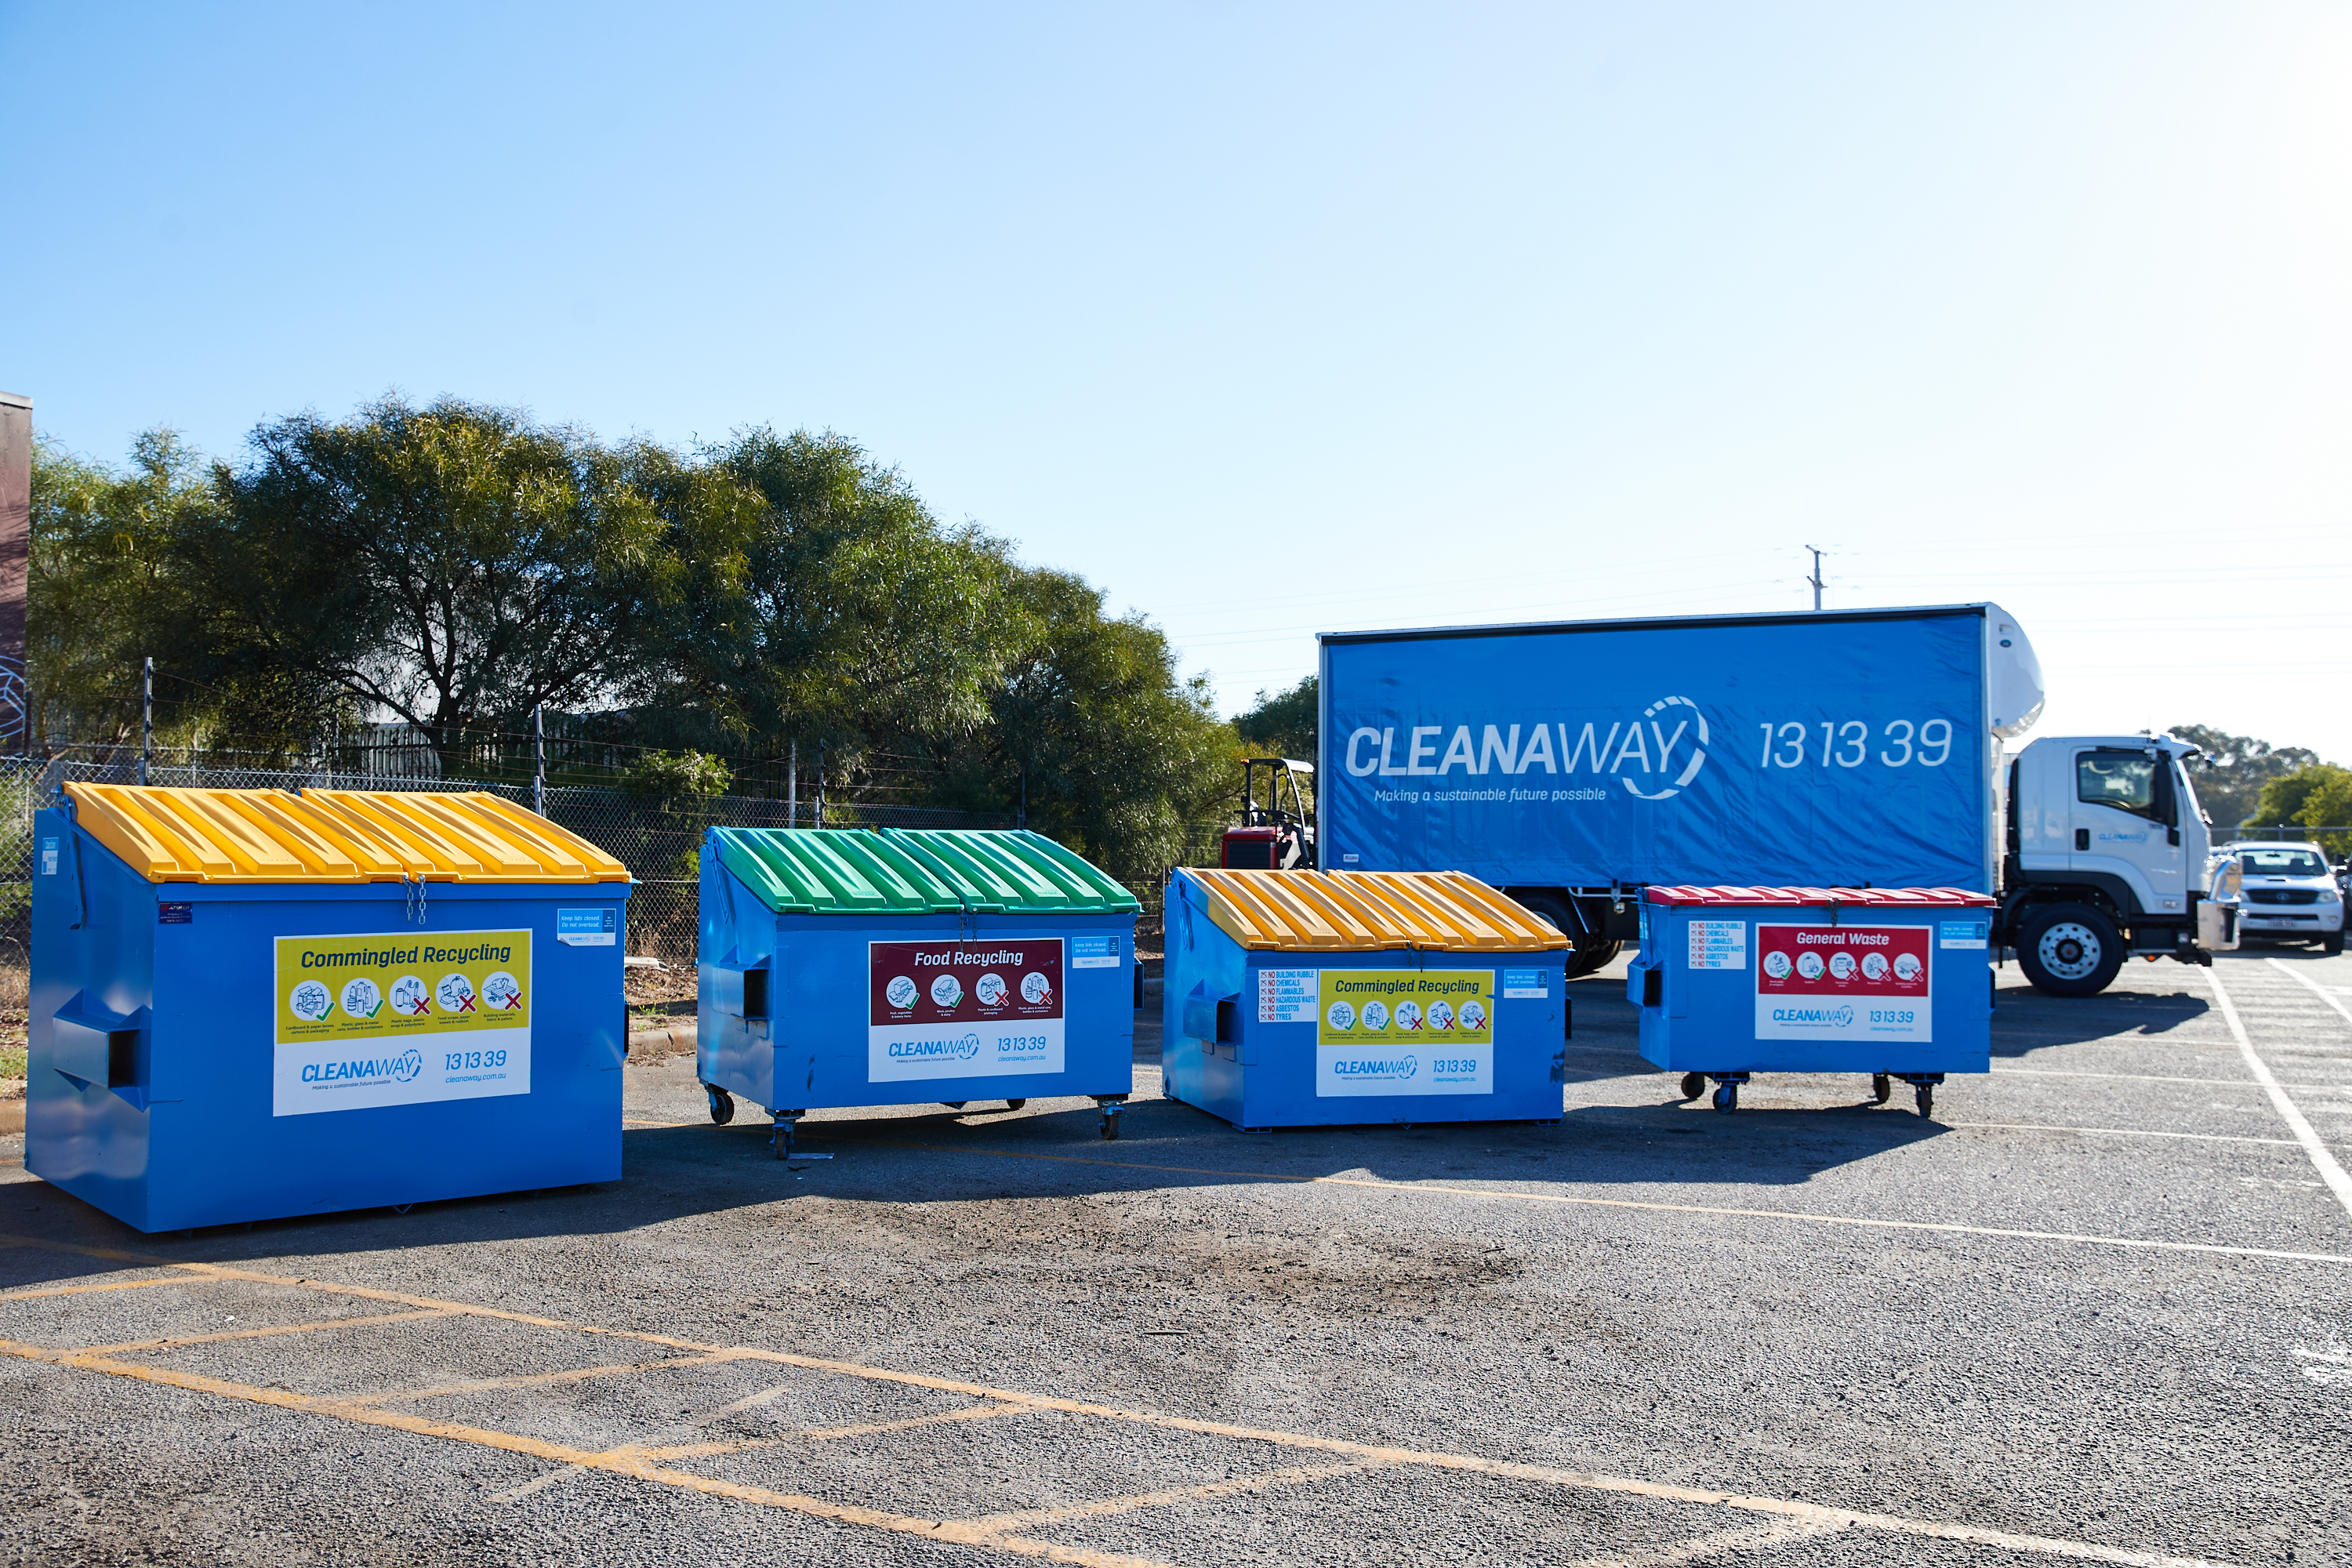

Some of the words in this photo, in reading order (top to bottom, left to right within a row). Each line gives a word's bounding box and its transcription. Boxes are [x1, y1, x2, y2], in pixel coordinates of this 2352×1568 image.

[1345, 720, 1689, 777] CLEANAWAY
[1760, 721, 1806, 768] 13
[1820, 720, 1868, 768] 13
[1881, 719, 1952, 767] 39
[1374, 789, 1418, 803] Making
[1422, 791, 1431, 801] a
[1434, 788, 1506, 801] sustainable
[1508, 788, 1548, 802] future
[1551, 788, 1606, 802] possible
[1797, 932, 1846, 945] General
[1849, 933, 1889, 945] Waste
[301, 946, 419, 968] Commingled
[423, 944, 511, 964] Recycling
[914, 950, 950, 966] Food
[953, 949, 1023, 967] Recycling
[1335, 980, 1414, 994] Commingled
[1418, 980, 1479, 994] Recycling
[1773, 1009, 1849, 1022] CLEANAWAY
[1870, 1011, 1882, 1022] 13
[1883, 1011, 1895, 1022] 13
[1897, 1011, 1914, 1023] 39
[888, 1039, 975, 1057] CLEANAWAY
[997, 1038, 1011, 1051] 13
[1013, 1037, 1025, 1051] 13
[1028, 1036, 1047, 1050] 39
[445, 1054, 461, 1070] 13
[465, 1052, 481, 1069] 13
[483, 1050, 506, 1068] 39
[1334, 1061, 1413, 1074] CLEANAWAY
[1433, 1060, 1446, 1073] 13
[1446, 1060, 1458, 1073] 13
[1460, 1059, 1476, 1073] 39
[301, 1056, 416, 1083] CLEANAWAY
[445, 1073, 506, 1083] cleanaway.com.au
